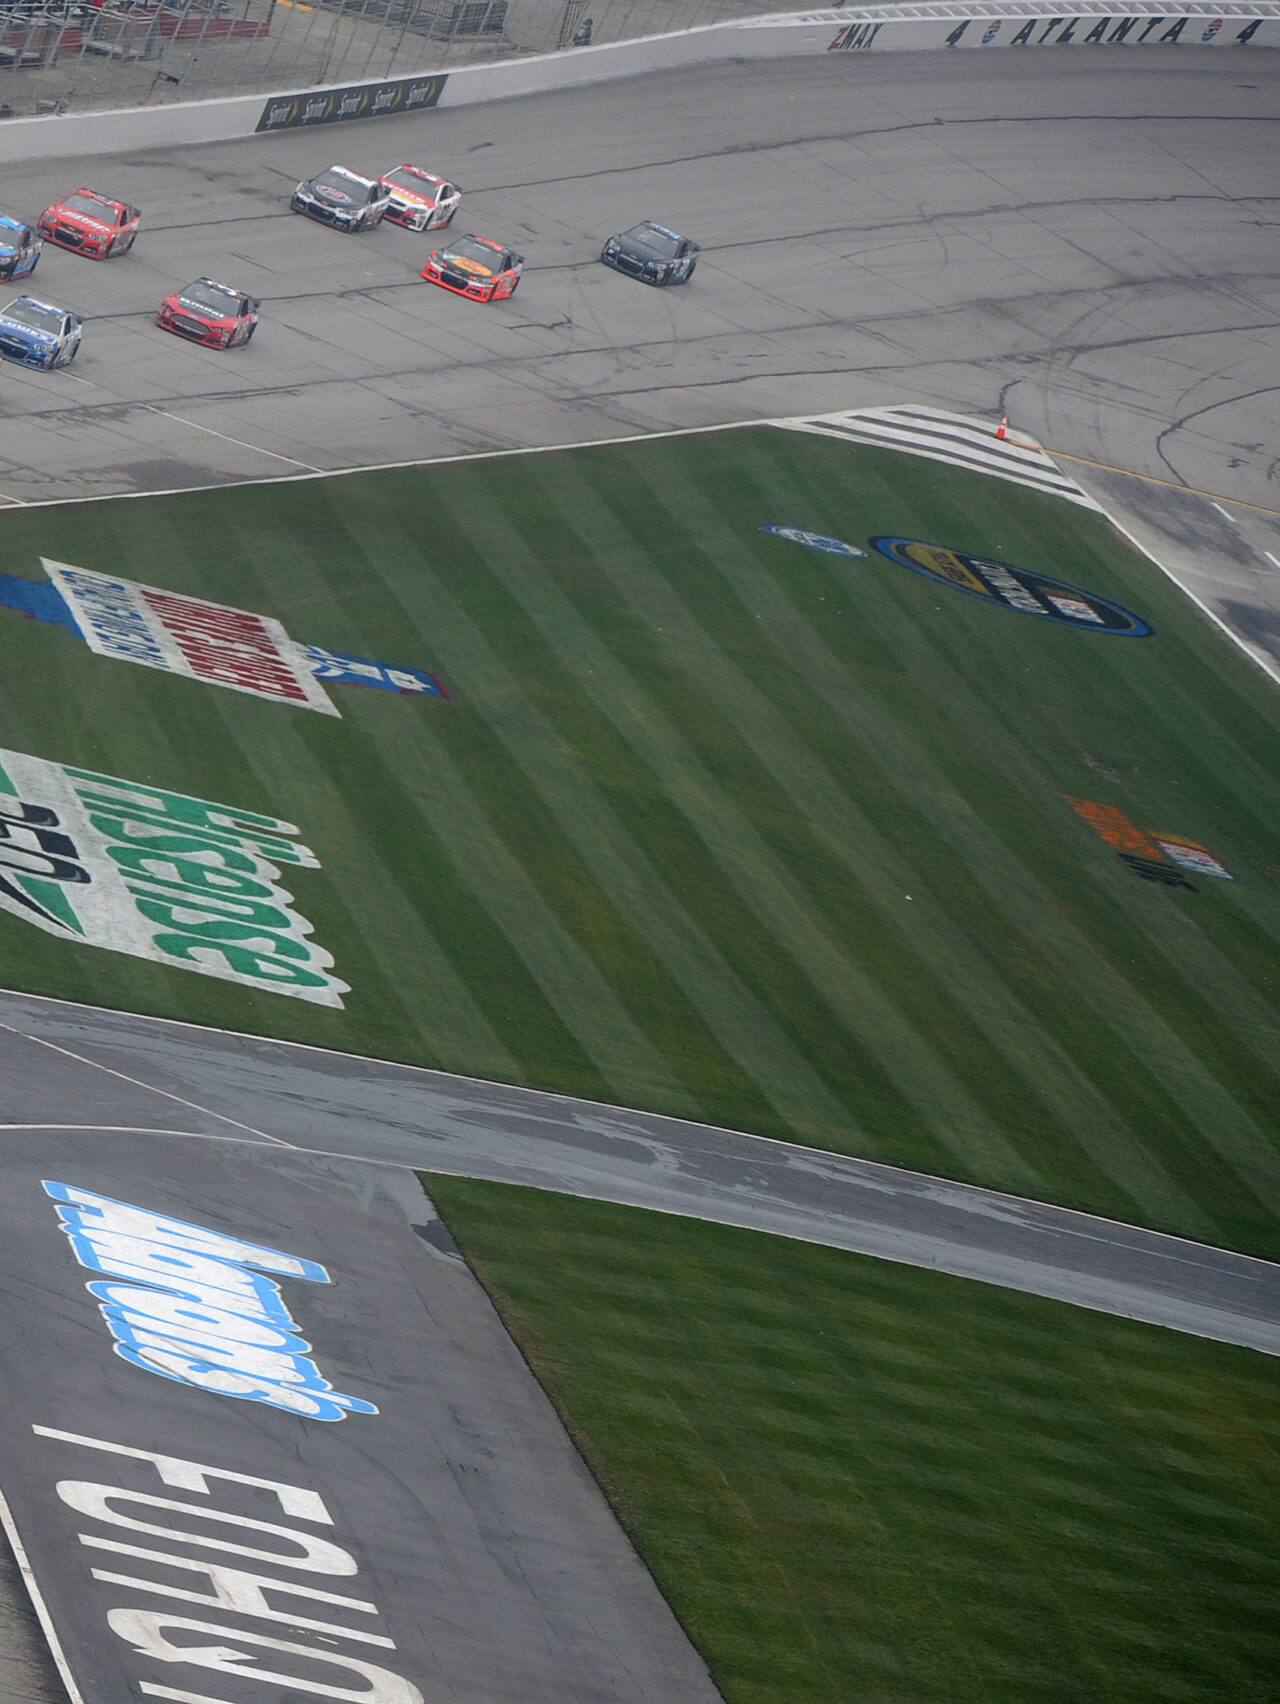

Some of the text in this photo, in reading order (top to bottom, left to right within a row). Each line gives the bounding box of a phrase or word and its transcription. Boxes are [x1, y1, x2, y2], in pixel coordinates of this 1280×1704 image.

[945, 20, 972, 47] 4
[1010, 17, 1190, 46] ATLANTA
[1236, 19, 1265, 44] 4
[137, 587, 313, 706] DRIVE SOBER
[61, 766, 330, 988] Hisense
[48, 1182, 370, 1420] Aaron's
